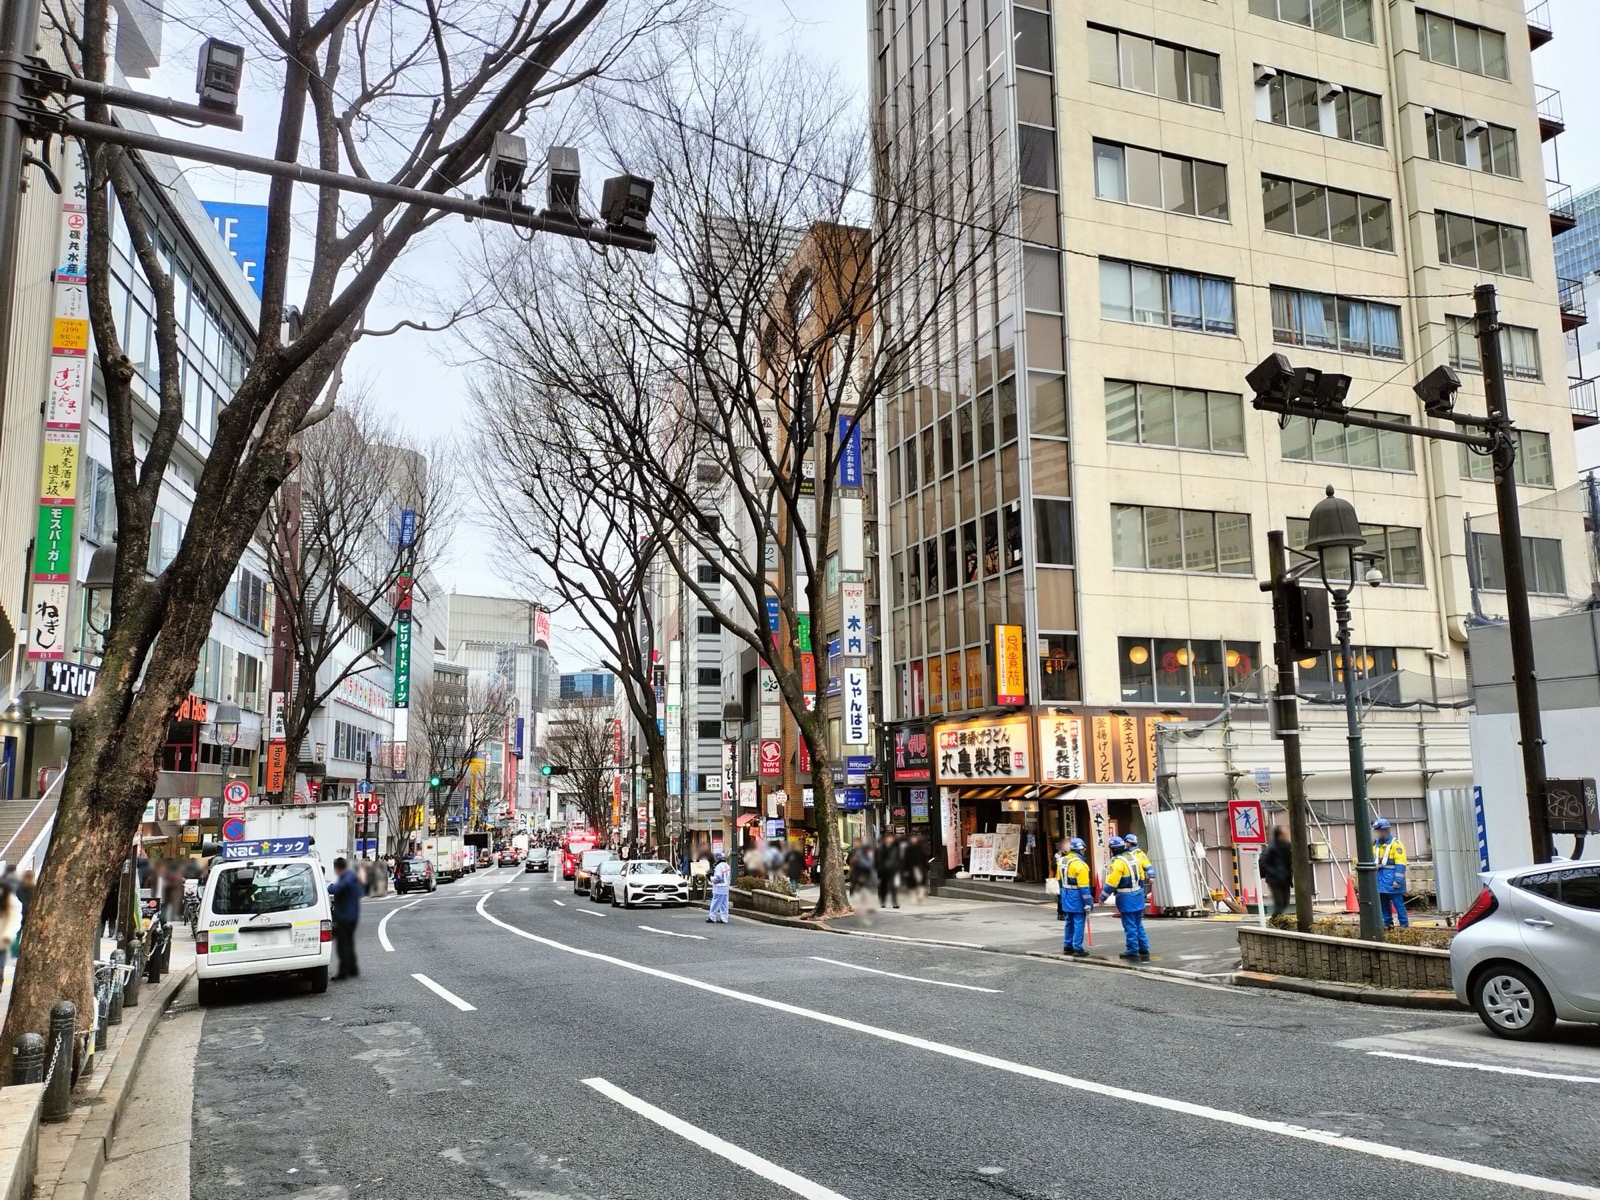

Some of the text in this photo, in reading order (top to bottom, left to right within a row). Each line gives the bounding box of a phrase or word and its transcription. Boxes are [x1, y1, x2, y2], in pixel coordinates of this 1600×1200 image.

[67, 230, 80, 274] 磯丸水産
[54, 367, 77, 415] すしざんまい
[46, 464, 61, 497] 道玄坂
[47, 508, 63, 571] モスバーガー
[35, 600, 59, 649] ねぎし
[847, 615, 862, 653] 木内
[52, 661, 96, 697] サンマルク
[398, 624, 409, 701] ビリヤード・ダーツ
[1007, 634, 1020, 687] 鳥貴族
[191, 695, 208, 722] Host
[908, 733, 927, 758] HUB
[959, 728, 1010, 746] 釜揚げうどん
[1054, 721, 1070, 779] 丸亀製麺
[1096, 718, 1110, 782] 釜揚げうどん
[1122, 718, 1137, 782] 釜玉うどん
[272, 747, 283, 789] Royal Host
[941, 746, 1011, 777] 丸亀製麺
[273, 841, 304, 853] ナック
[209, 918, 239, 928] DUSKIN
